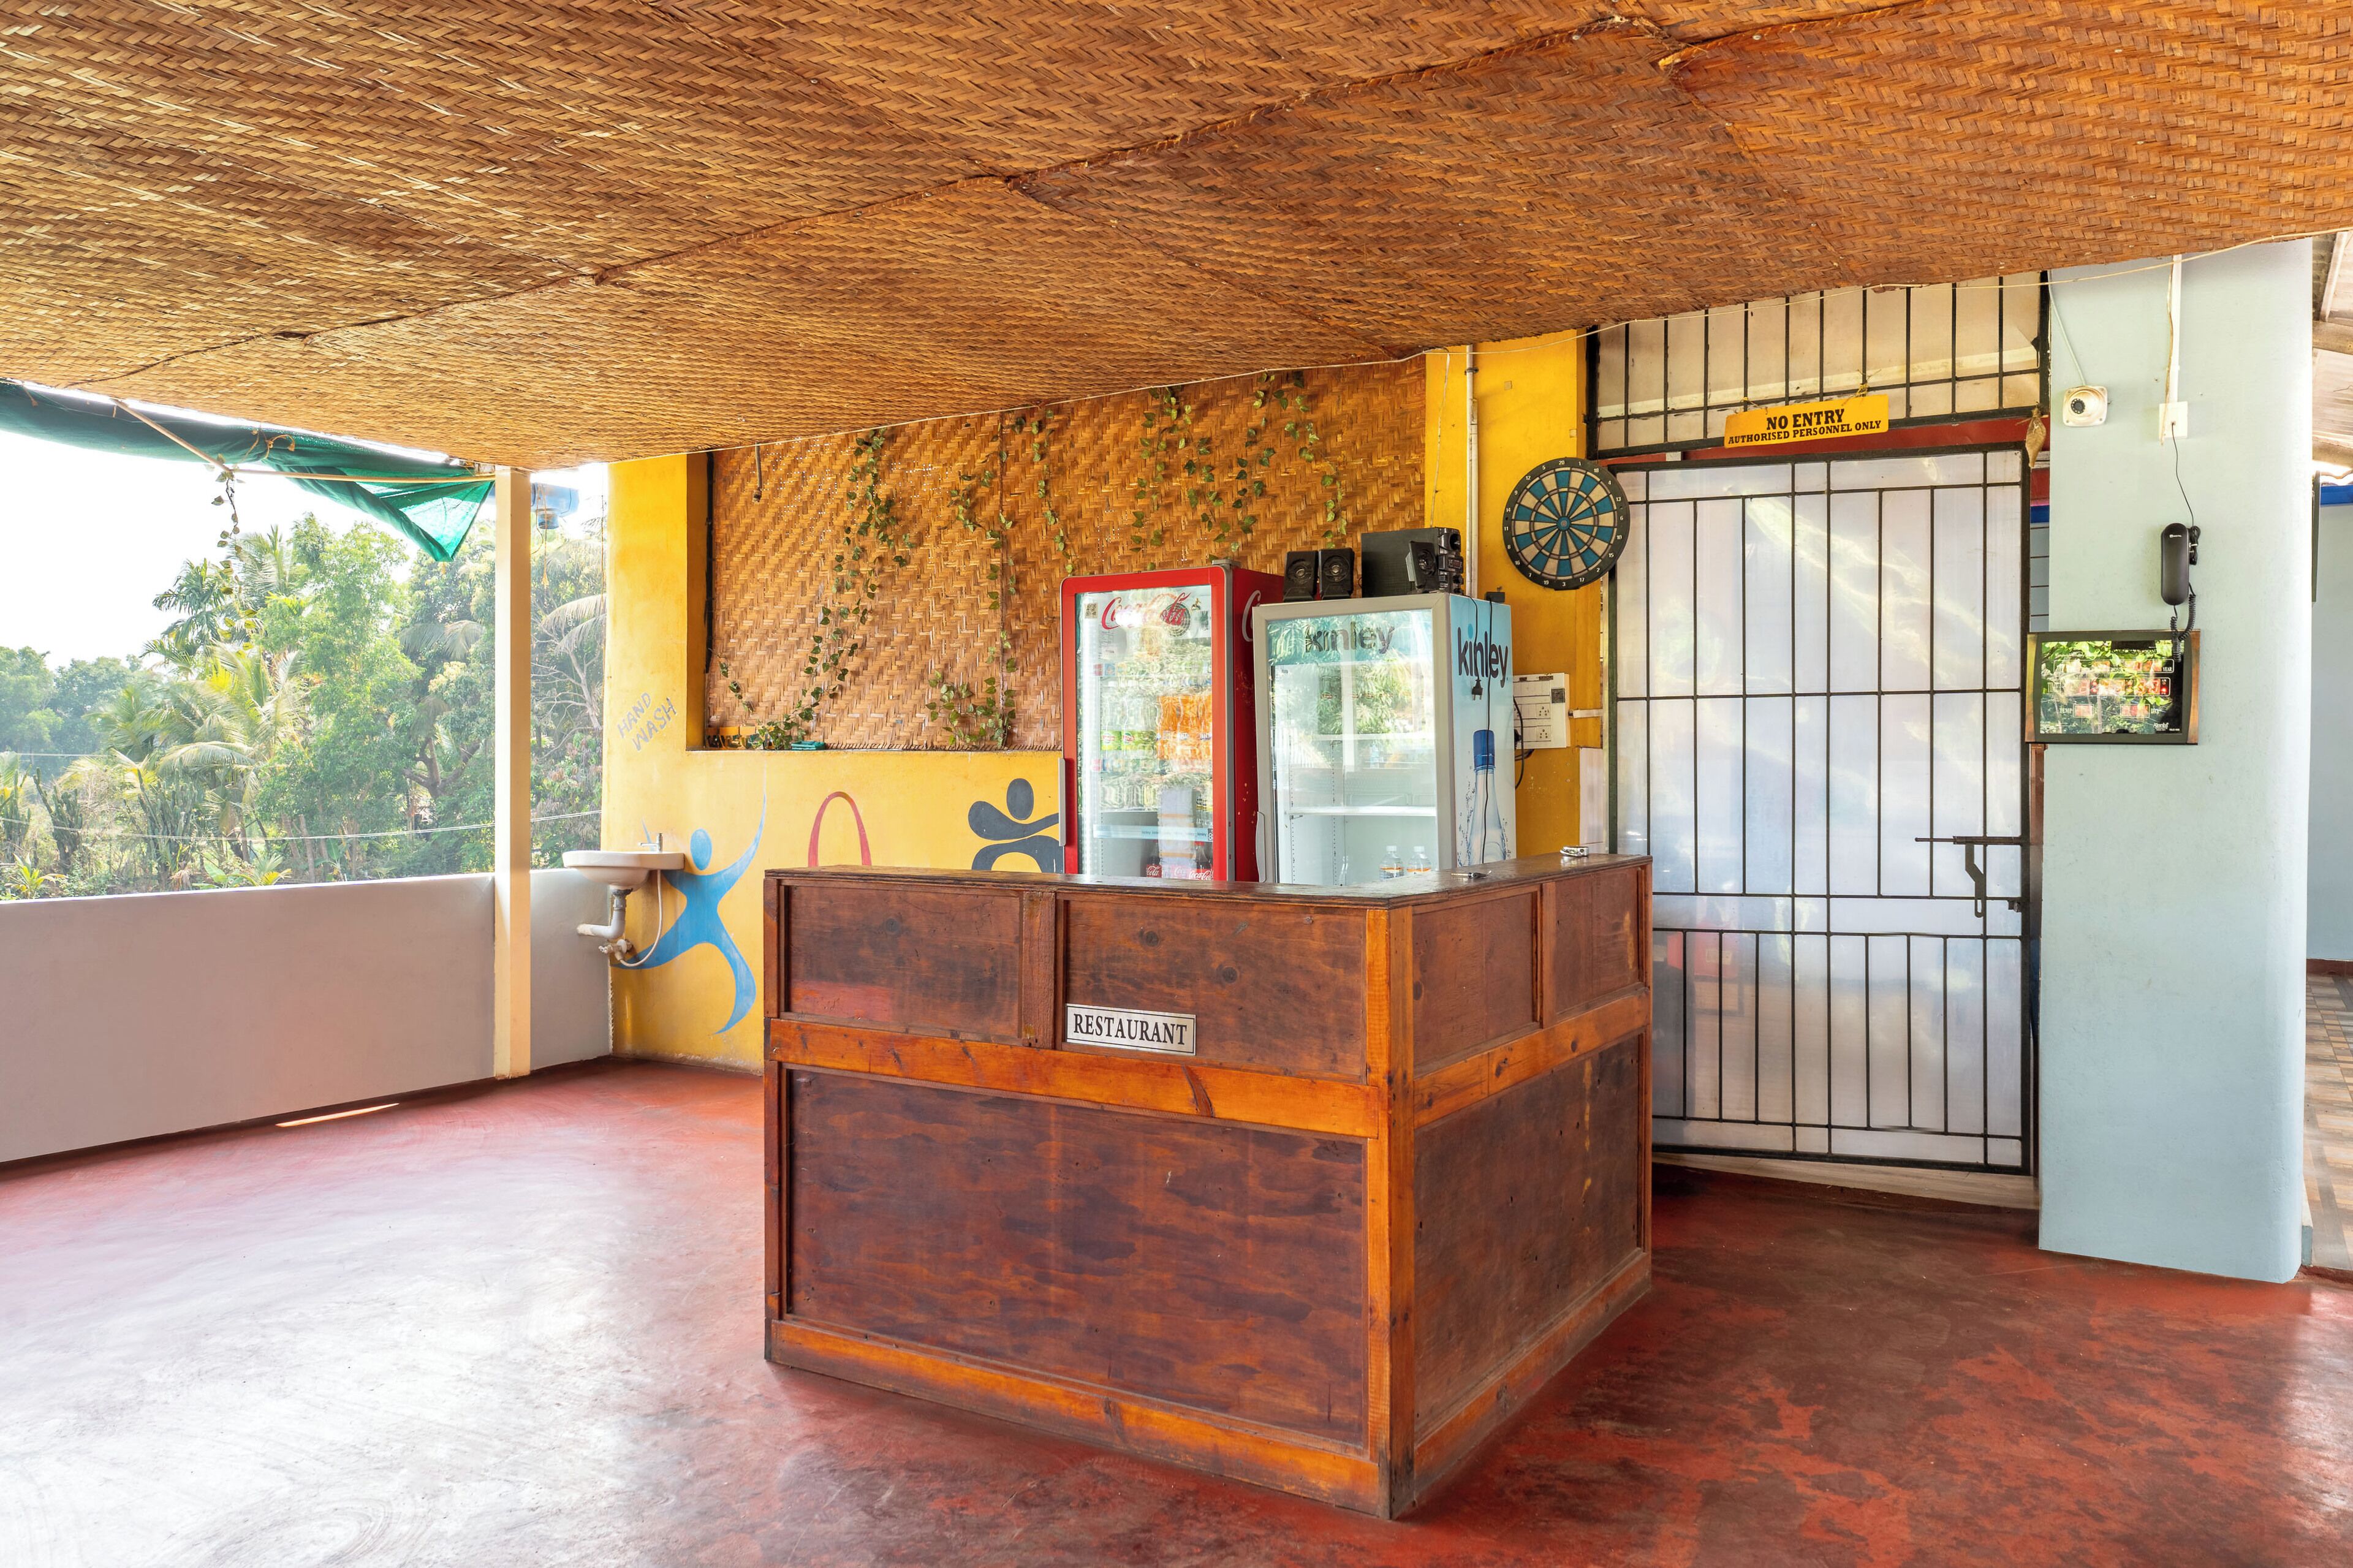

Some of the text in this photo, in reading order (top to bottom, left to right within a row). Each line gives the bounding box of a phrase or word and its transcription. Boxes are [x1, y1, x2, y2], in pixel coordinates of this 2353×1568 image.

[1727, 420, 1881, 444] AUTHORISED PERSONNEL ONLY
[1766, 408, 1845, 430] NO ENTRY
[1305, 621, 1395, 654] kinley
[1458, 624, 1508, 688] kinley
[617, 692, 651, 738] HAND
[632, 697, 677, 751] WASH
[1073, 1013, 1188, 1045] RESTAURANT
